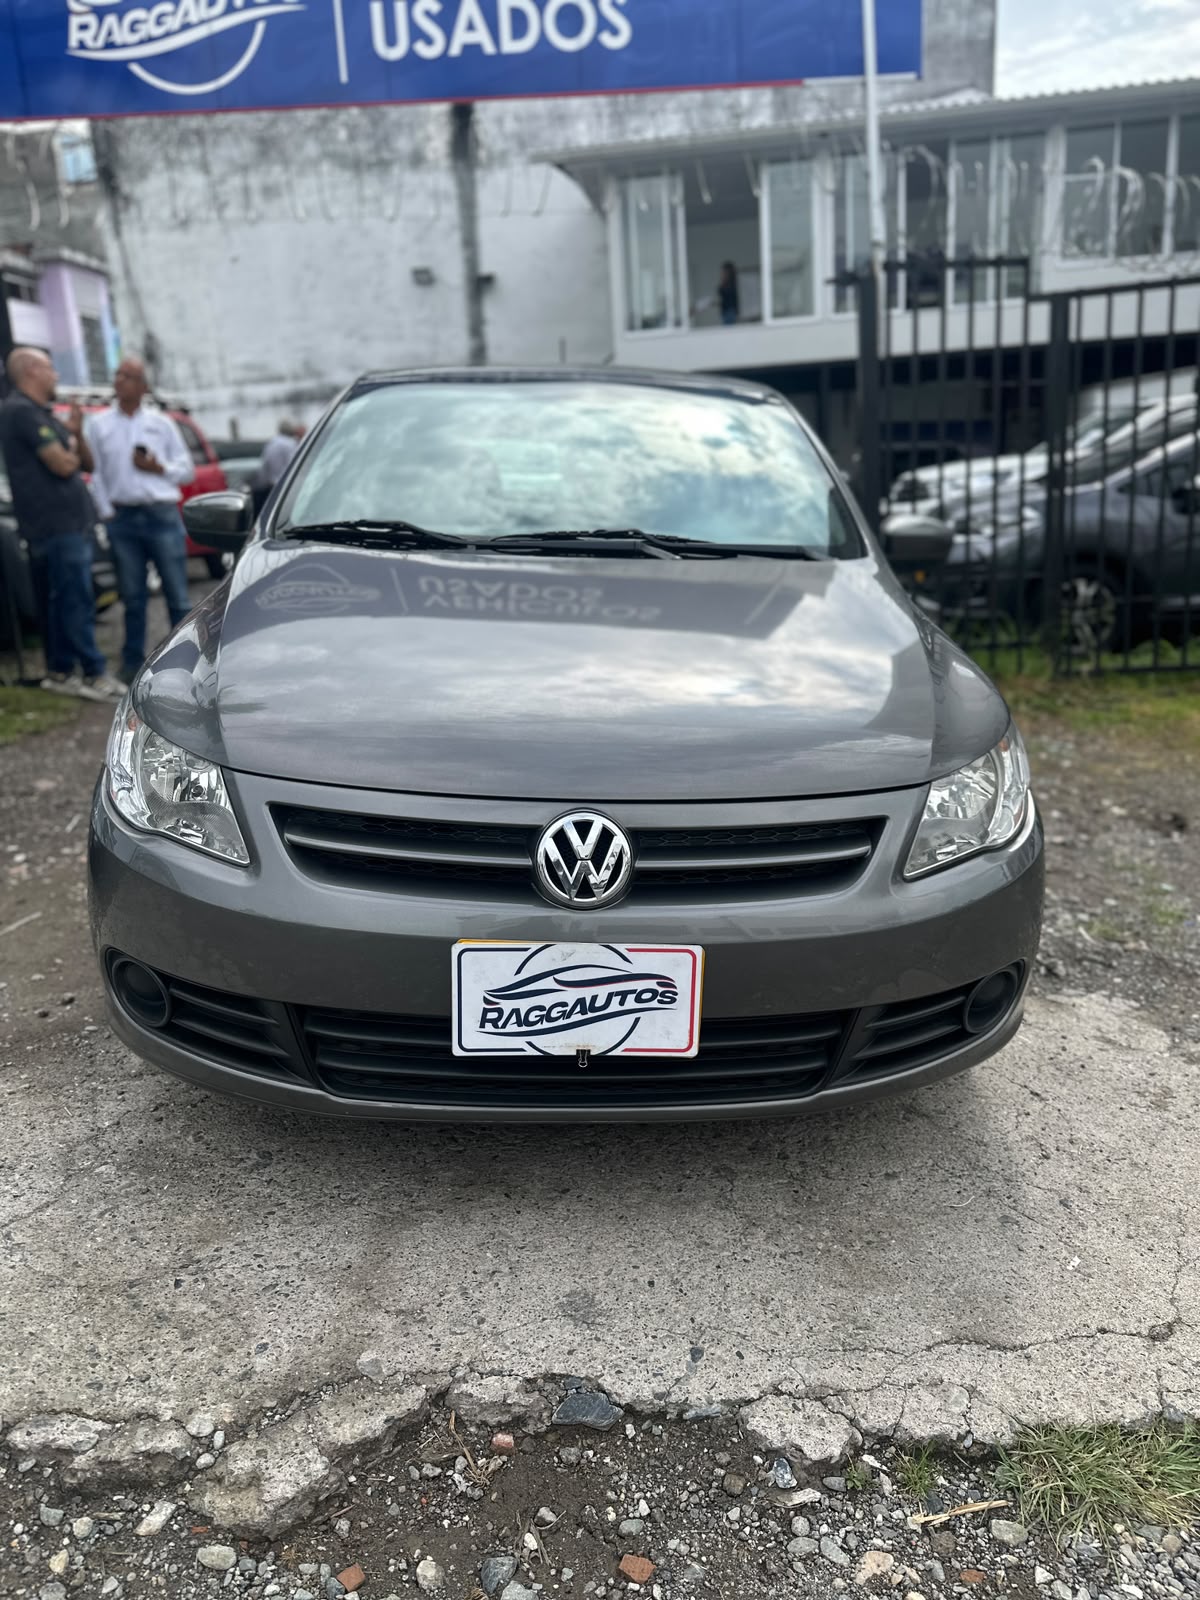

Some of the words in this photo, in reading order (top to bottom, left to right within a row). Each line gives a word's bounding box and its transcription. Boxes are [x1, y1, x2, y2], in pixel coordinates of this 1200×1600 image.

[67, 0, 302, 50] RAGGAU
[369, 0, 633, 61] USADOS
[538, 813, 632, 904] VW
[478, 988, 679, 1030] RAGGAUTOS
